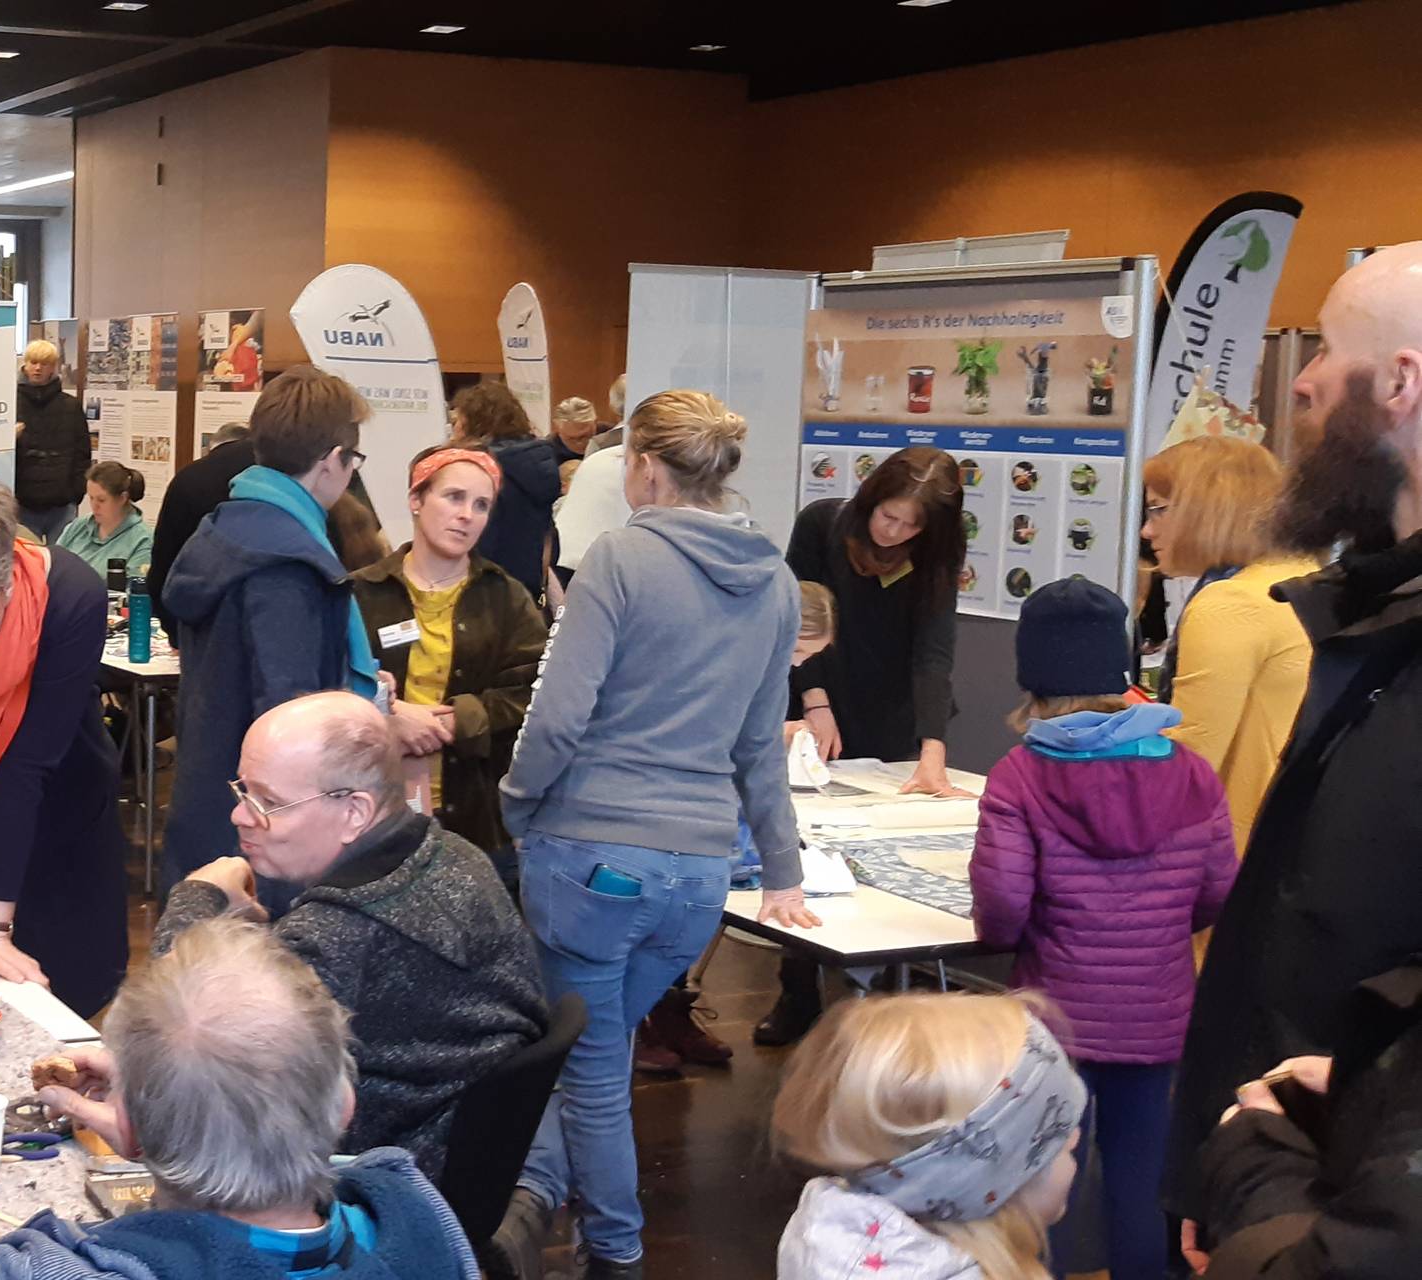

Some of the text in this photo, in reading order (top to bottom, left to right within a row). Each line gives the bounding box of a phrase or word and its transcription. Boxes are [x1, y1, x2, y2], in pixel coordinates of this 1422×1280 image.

[866, 316, 884, 329] Die
[888, 316, 919, 329] sechs
[944, 313, 964, 327] der
[968, 311, 1064, 328] Nachhaltigkeit
